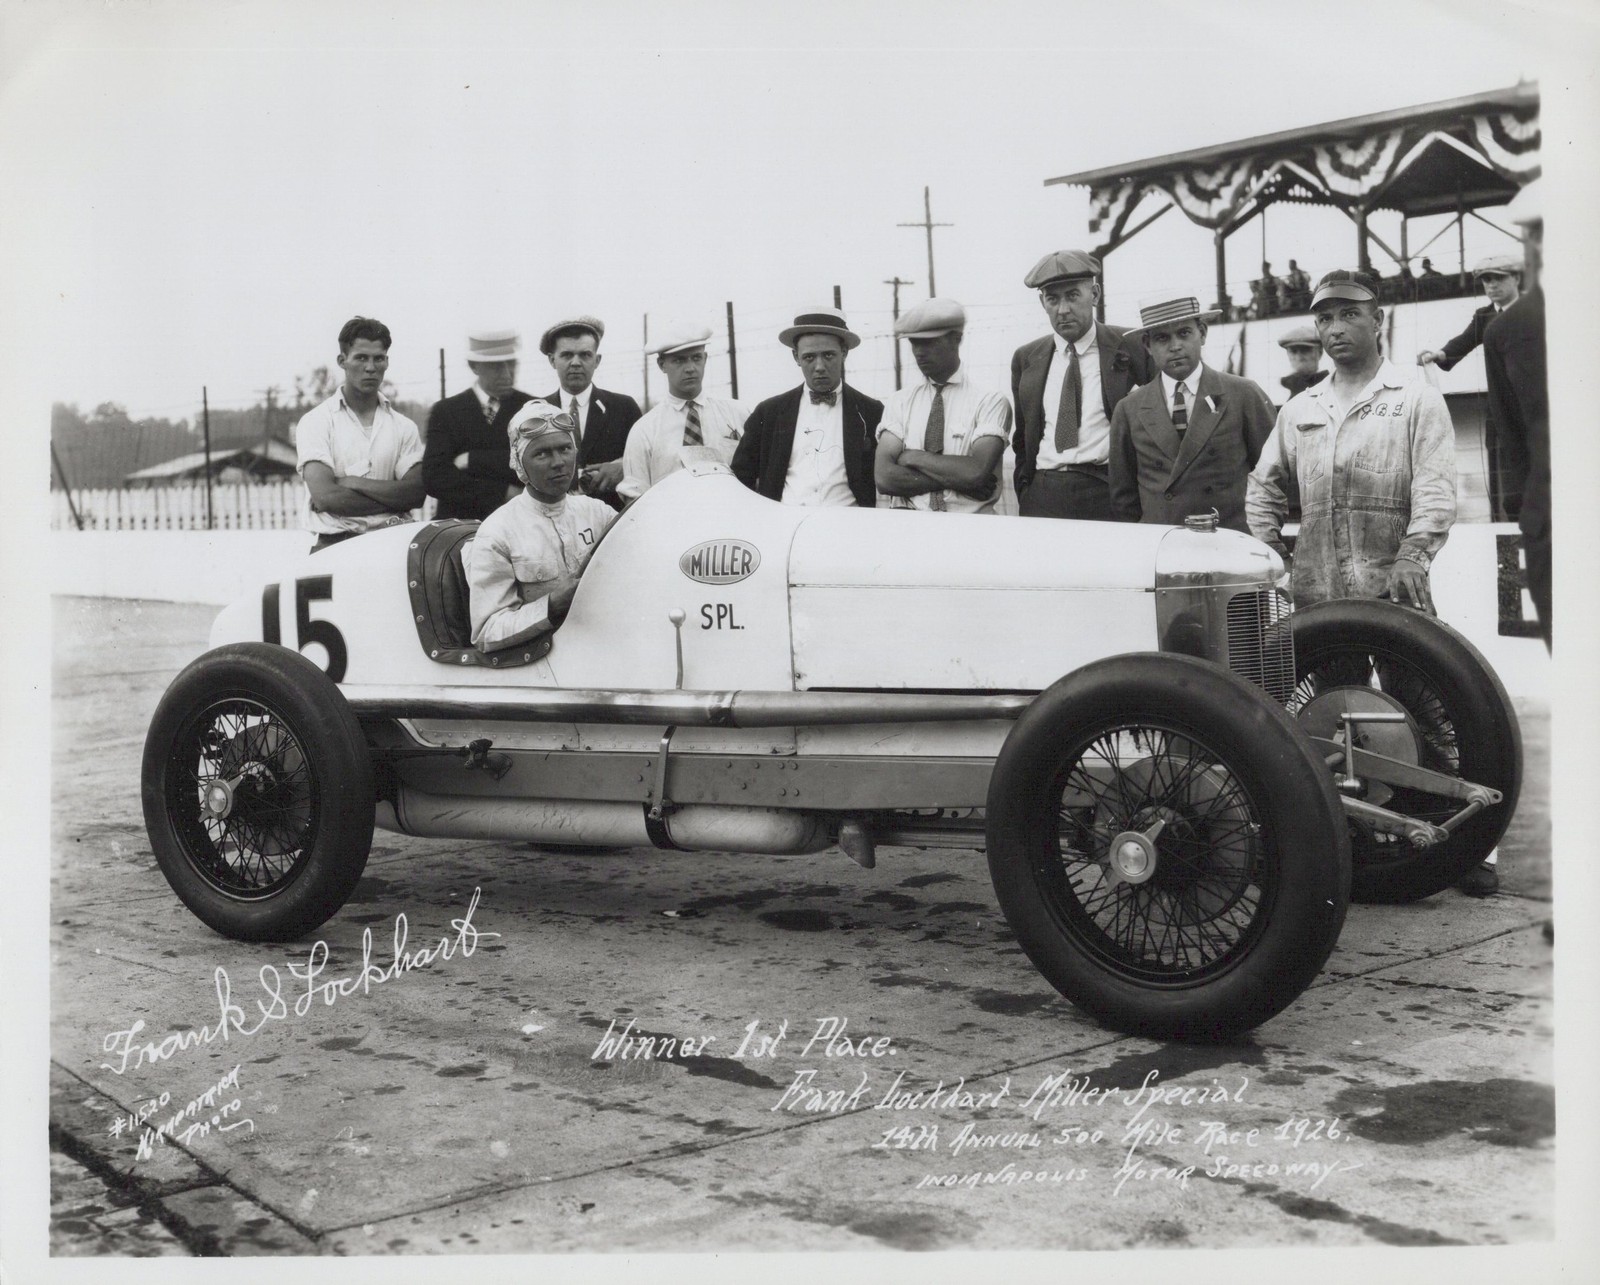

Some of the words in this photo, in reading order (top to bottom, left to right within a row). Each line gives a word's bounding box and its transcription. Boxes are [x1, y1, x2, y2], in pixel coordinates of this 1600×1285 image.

[691, 544, 753, 577] MILLER
[261, 573, 348, 684] 15
[700, 603, 745, 630] SPL.
